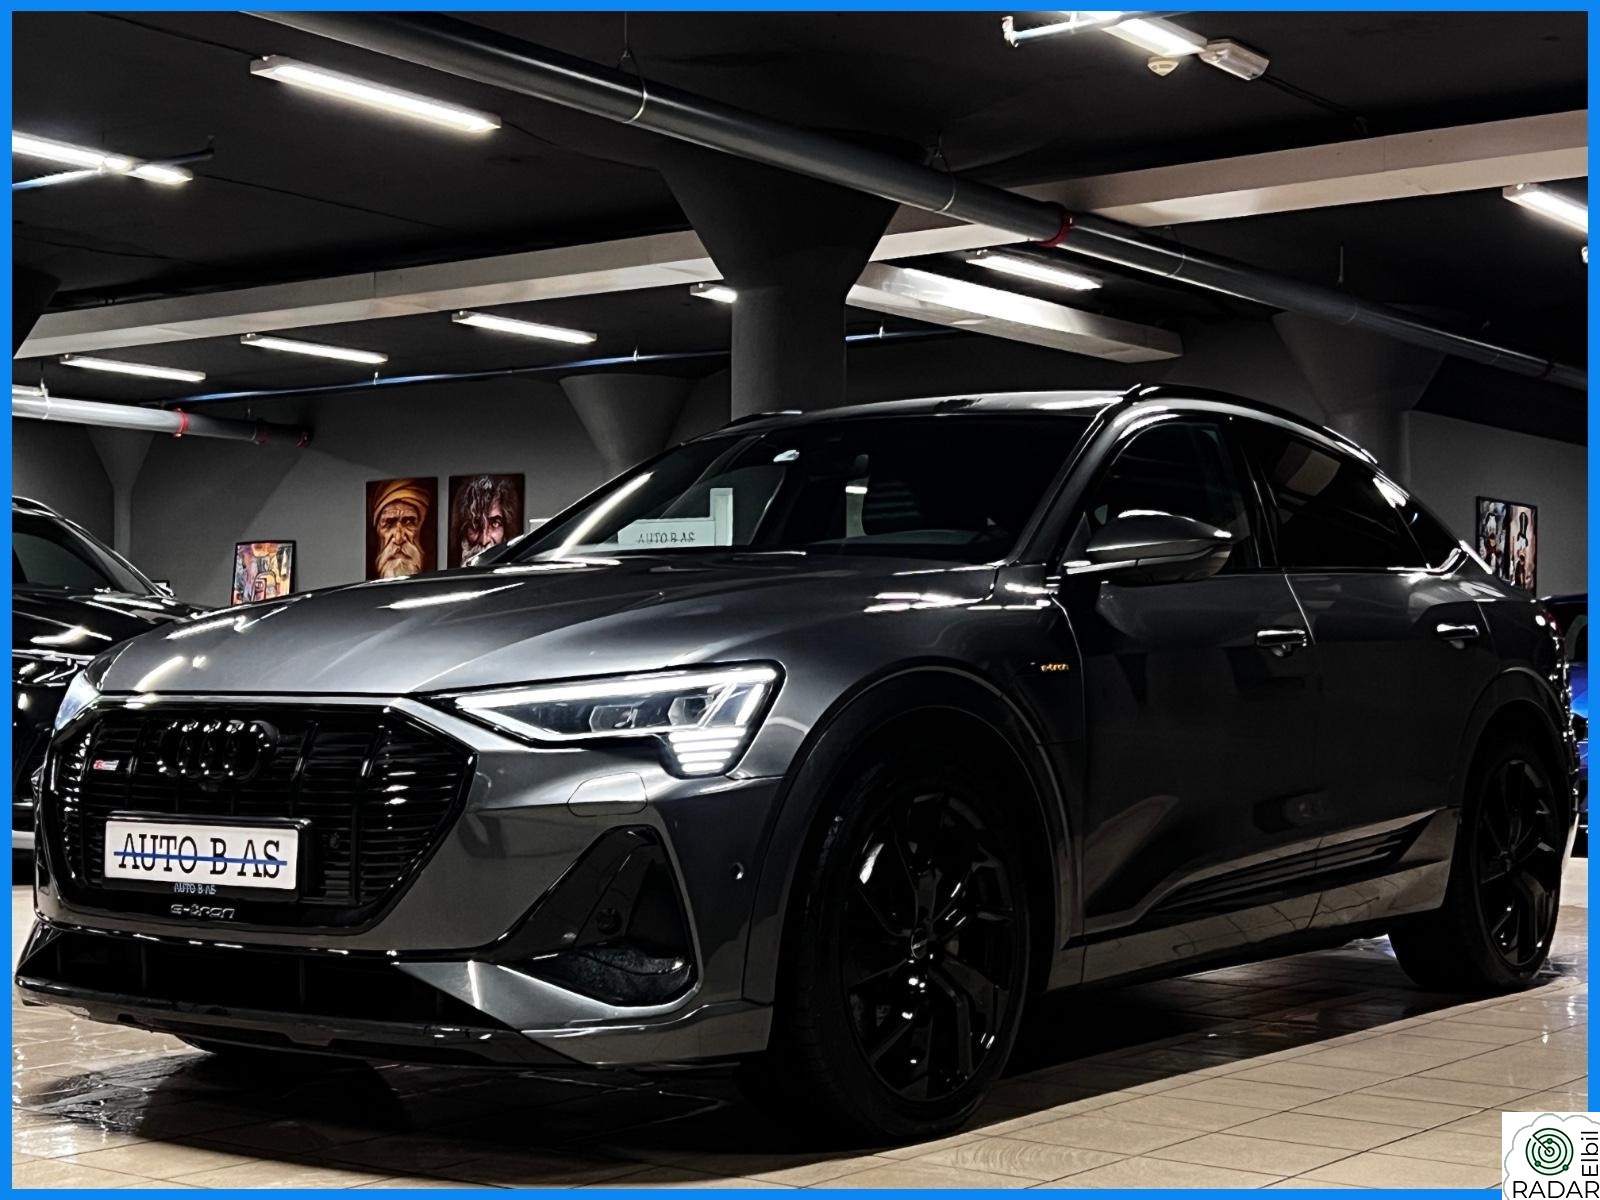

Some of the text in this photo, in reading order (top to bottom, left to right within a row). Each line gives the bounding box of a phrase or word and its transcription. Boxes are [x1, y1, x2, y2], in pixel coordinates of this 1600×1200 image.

[637, 532, 668, 544] AUTO
[118, 832, 198, 874] AUTO
[173, 882, 196, 894] AUTO
[170, 903, 235, 919] e-tron
